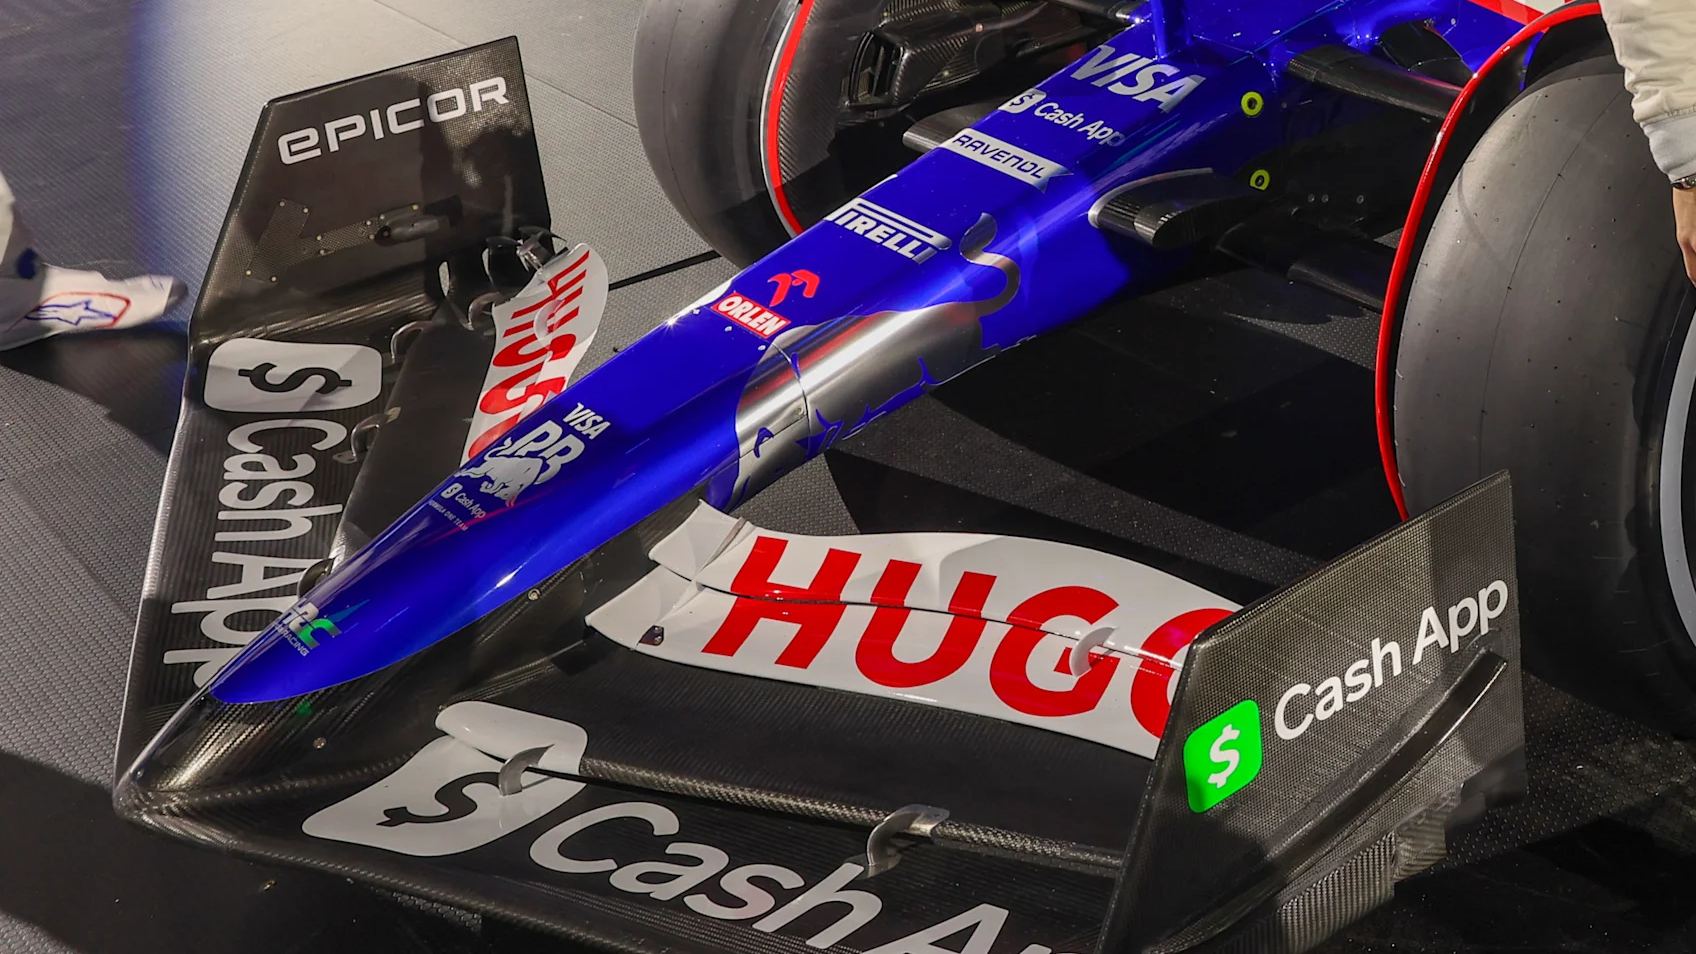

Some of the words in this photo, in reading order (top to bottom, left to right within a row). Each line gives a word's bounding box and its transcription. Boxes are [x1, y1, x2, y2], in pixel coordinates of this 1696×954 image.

[1070, 45, 1206, 113] VISA
[1033, 102, 1085, 130] Cash
[1080, 119, 1126, 147] App
[951, 134, 1050, 180] RAVENOL
[823, 197, 953, 265] PIRELLI
[716, 295, 787, 337] ORLEN
[562, 402, 612, 440] VISA
[214, 418, 348, 542] Cash
[455, 492, 474, 508] Cash
[468, 503, 487, 519] App
[1273, 636, 1403, 742] Cash
[1411, 578, 1509, 670] App
[529, 802, 882, 951] Cash
